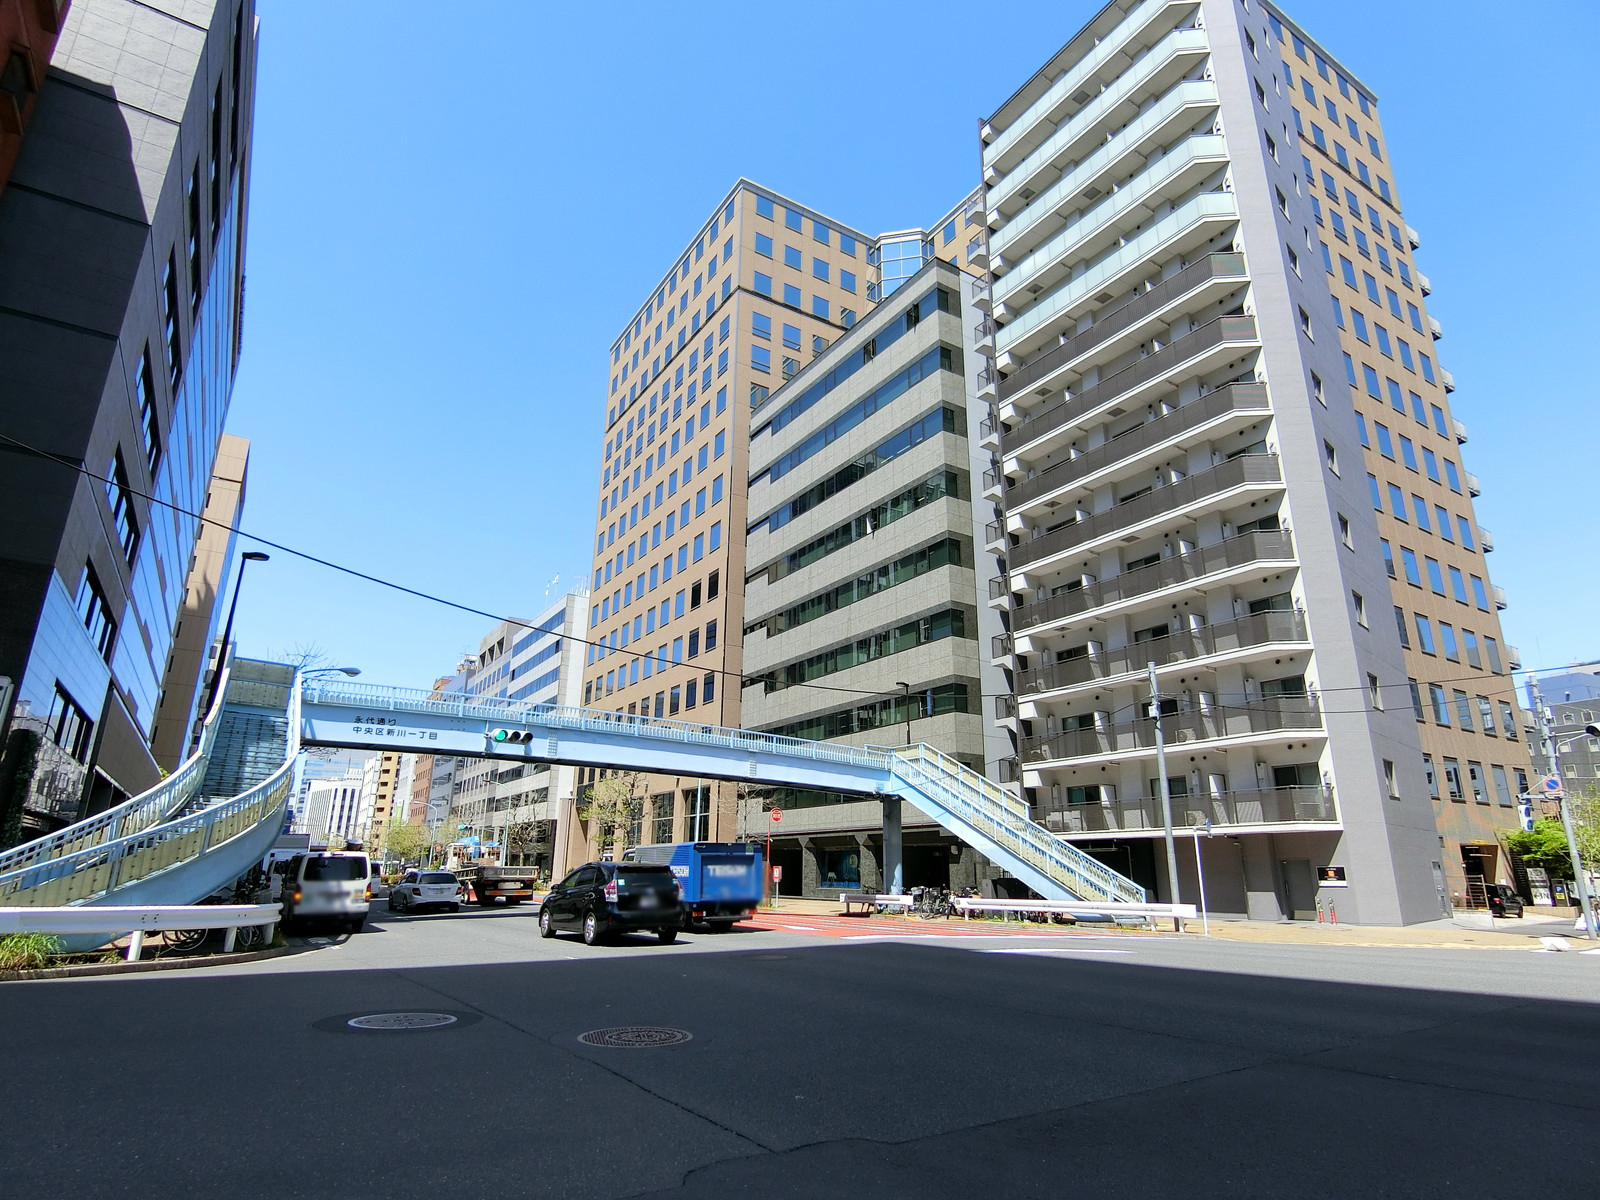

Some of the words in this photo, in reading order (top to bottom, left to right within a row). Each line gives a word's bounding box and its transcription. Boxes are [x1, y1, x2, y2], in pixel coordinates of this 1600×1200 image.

[354, 715, 397, 726] 永代通り
[352, 726, 438, 740] 中央区新川一丁目
